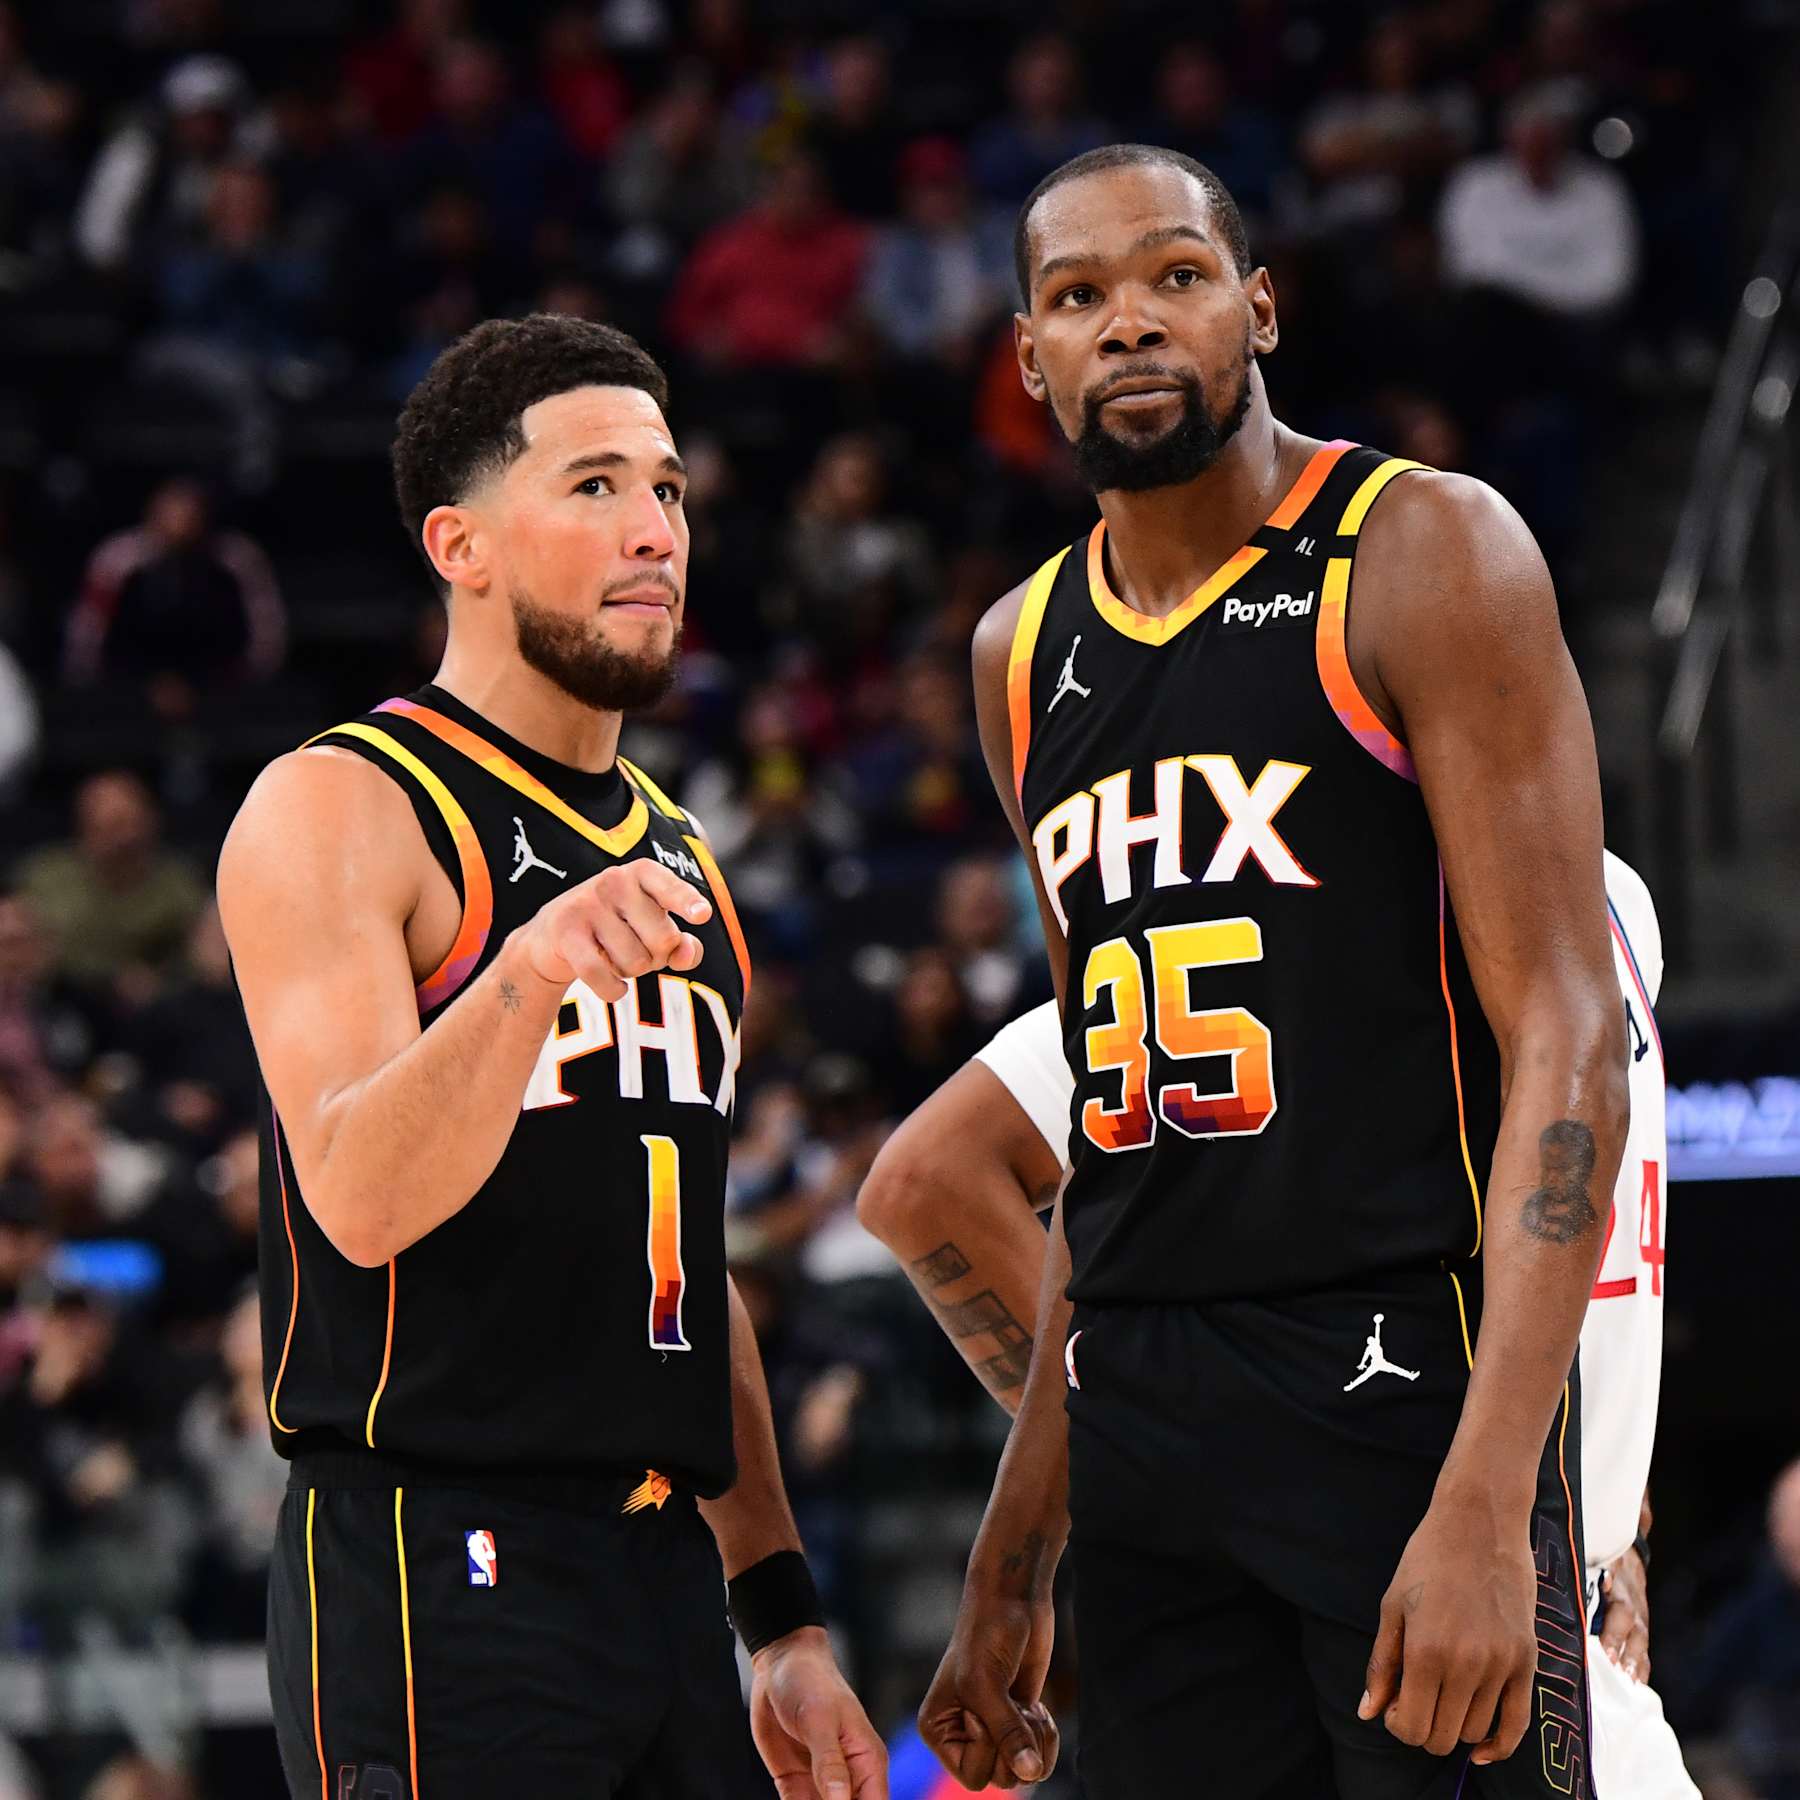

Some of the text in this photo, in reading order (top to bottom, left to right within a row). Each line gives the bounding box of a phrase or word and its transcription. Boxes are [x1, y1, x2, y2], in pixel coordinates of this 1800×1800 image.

[1222, 590, 1315, 628] PayPal
[1295, 536, 1316, 556] AL
[1032, 753, 1322, 939] PHX
[1082, 916, 1278, 1154] 35
[640, 1134, 692, 1352] 1
